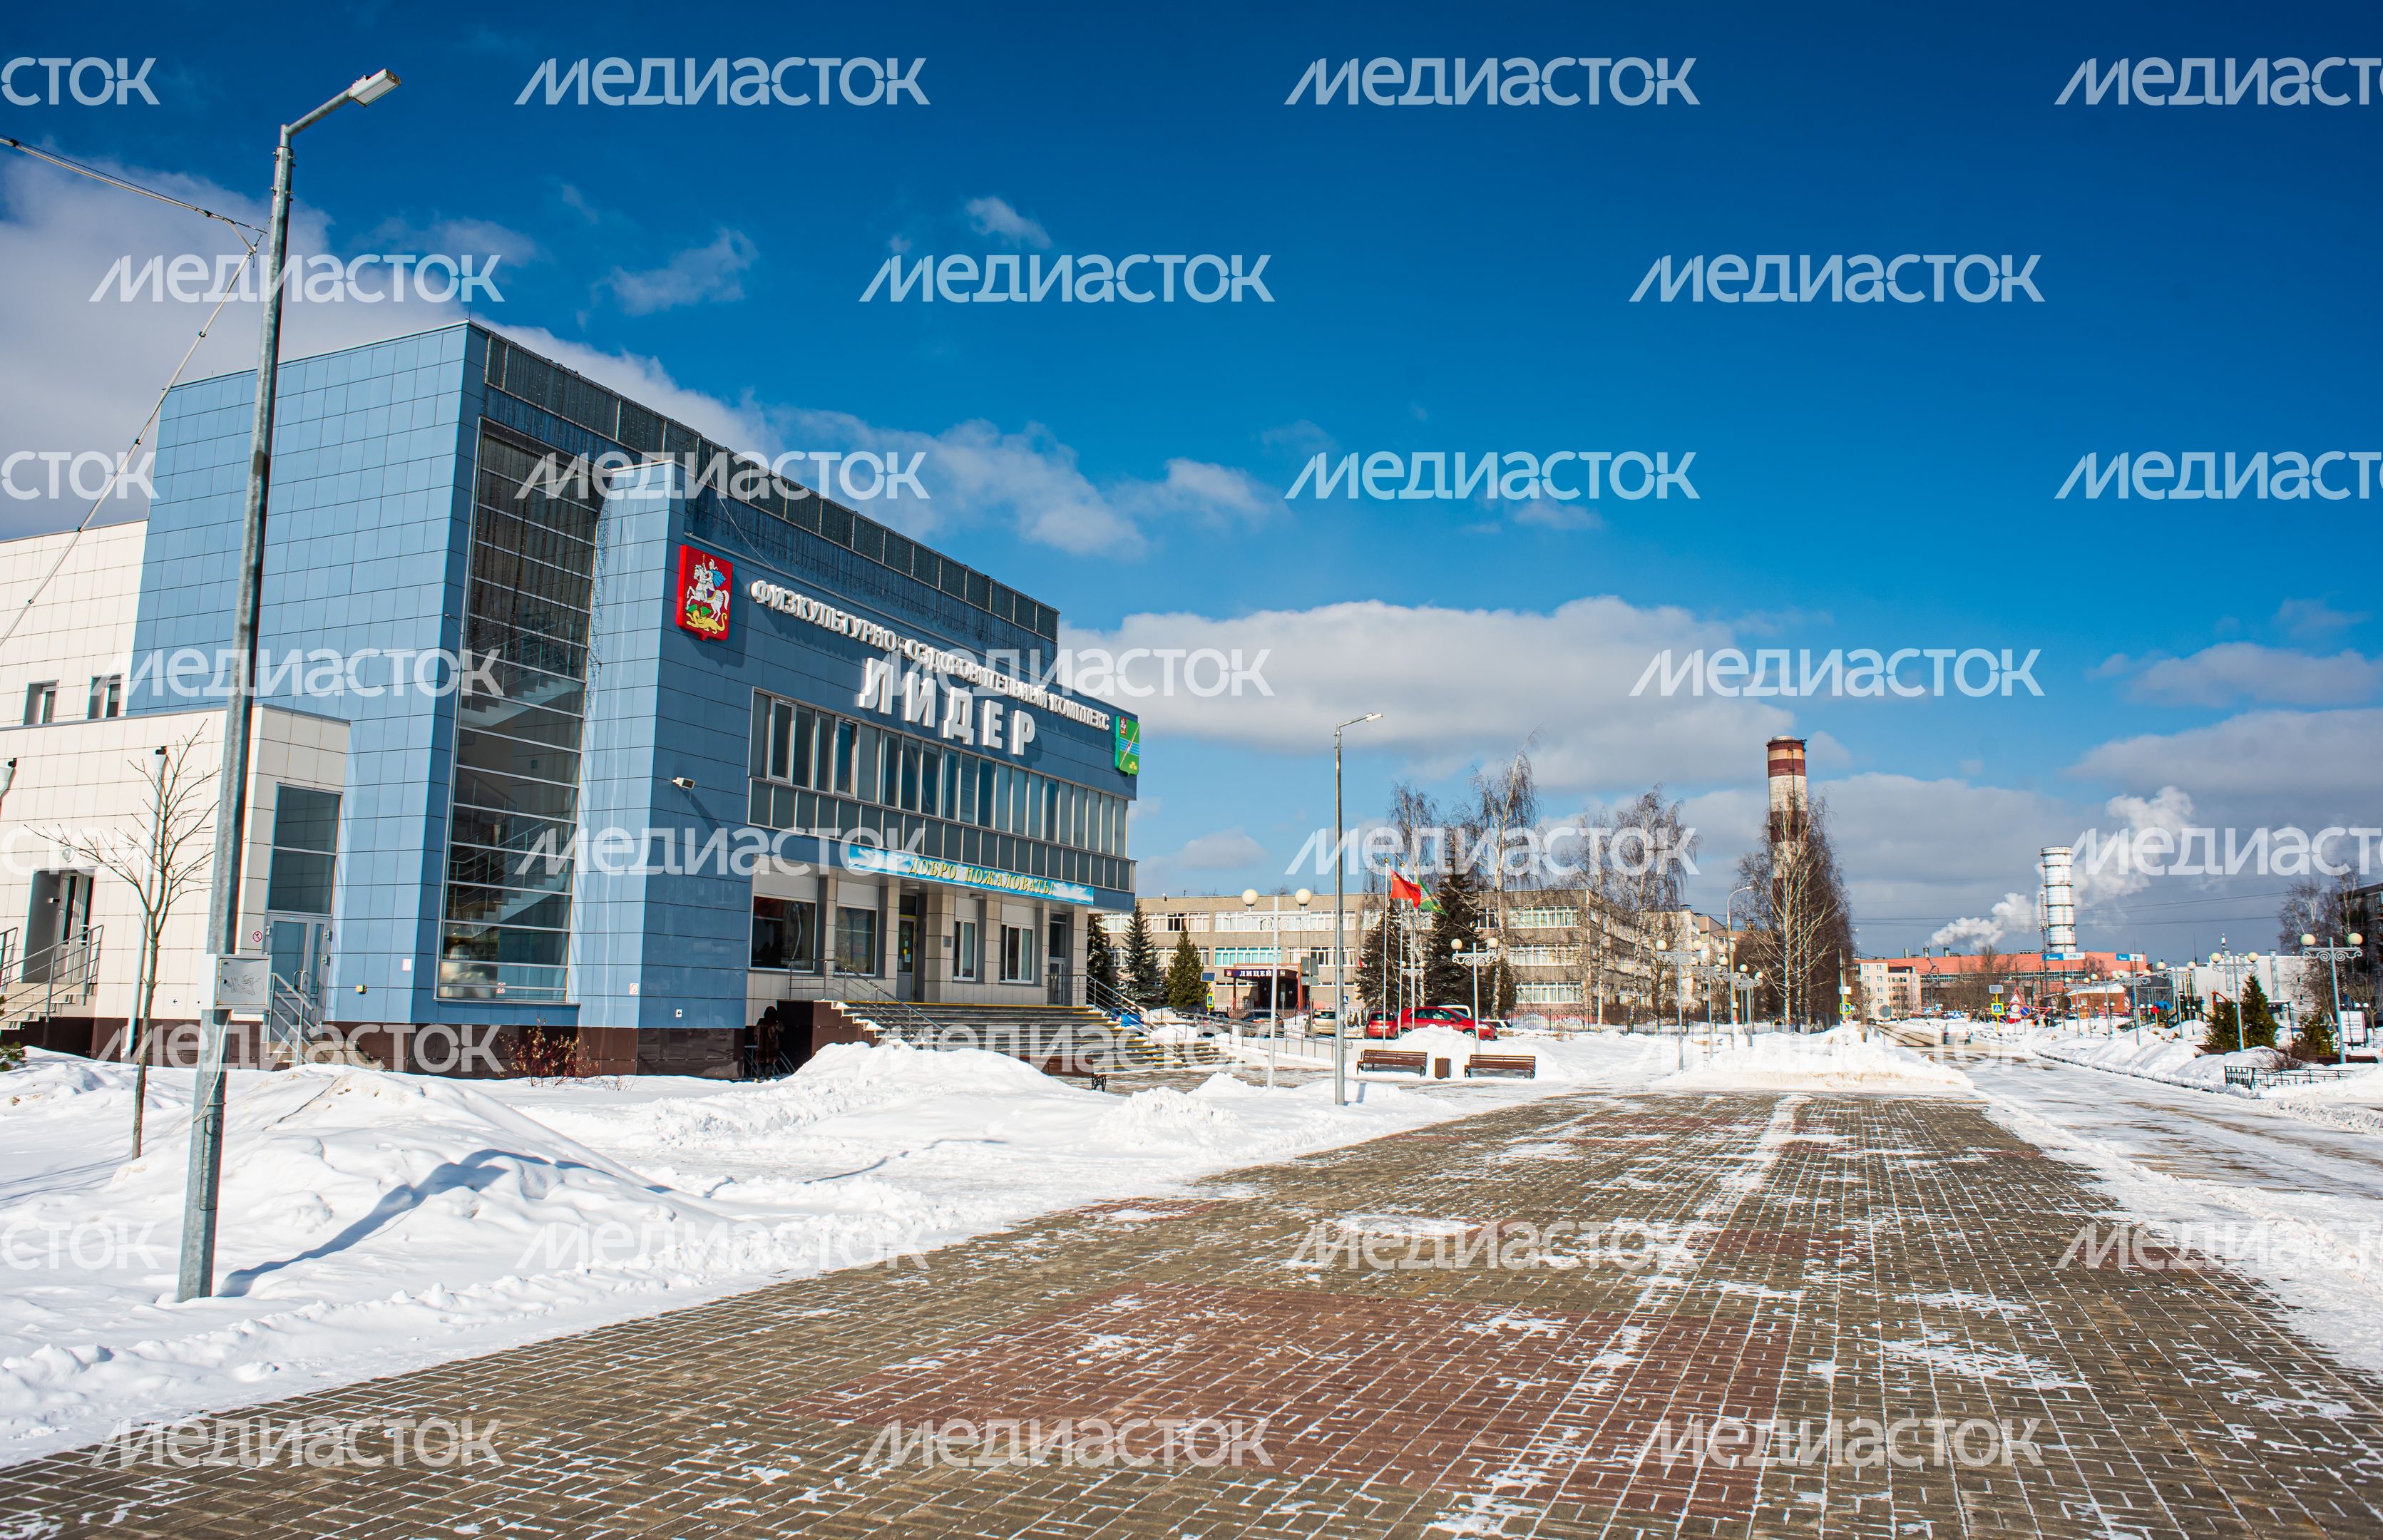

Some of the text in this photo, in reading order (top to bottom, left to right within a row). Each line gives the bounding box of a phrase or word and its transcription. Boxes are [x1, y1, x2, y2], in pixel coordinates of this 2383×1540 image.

[750, 580, 1110, 731] ФИЗКУЛЬТУРНО-ОЗДОРОВИТЕЛЬНЫЙ КОМПЛЕКС
[859, 657, 1035, 756] ЛИДЕР
[908, 858, 1055, 895] ДОБРО ПОЖАЛОВАТЬ!
[1239, 969, 1272, 977] ЛИЦЕЙ
